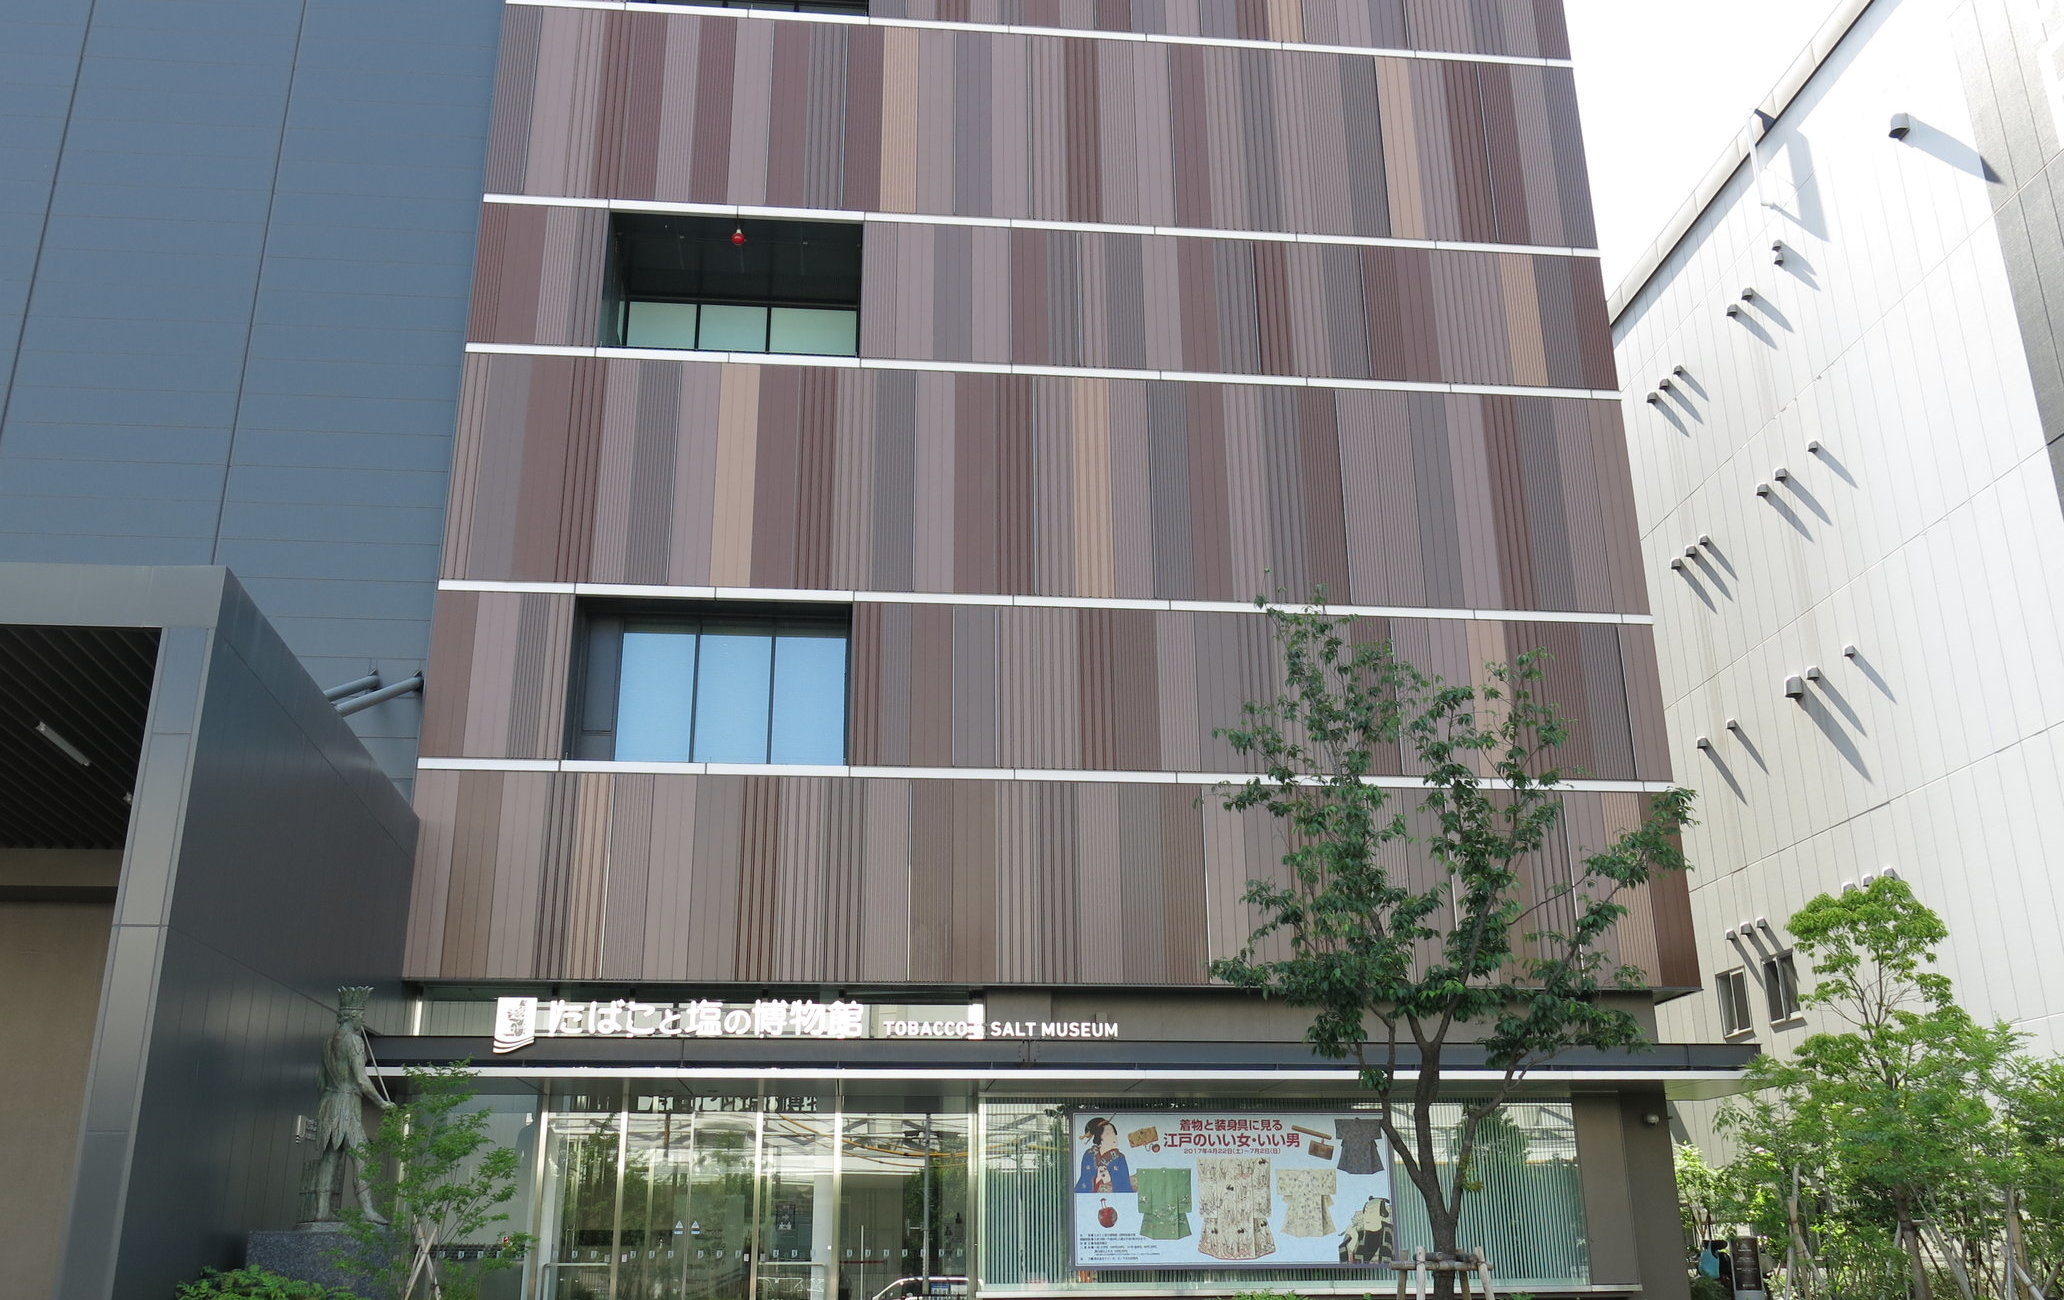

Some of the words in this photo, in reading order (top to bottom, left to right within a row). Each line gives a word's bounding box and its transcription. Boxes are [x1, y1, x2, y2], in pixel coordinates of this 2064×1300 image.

[550, 999, 864, 1039] たばこと塩の博物館
[882, 1020, 967, 1037] TOBACCO
[990, 1020, 1036, 1037] SALT
[1041, 1020, 1118, 1038] MUSEUM
[1180, 1118, 1283, 1132] 着物と装身具に見る
[1163, 1132, 1301, 1149] 江戸のいい女・いい男
